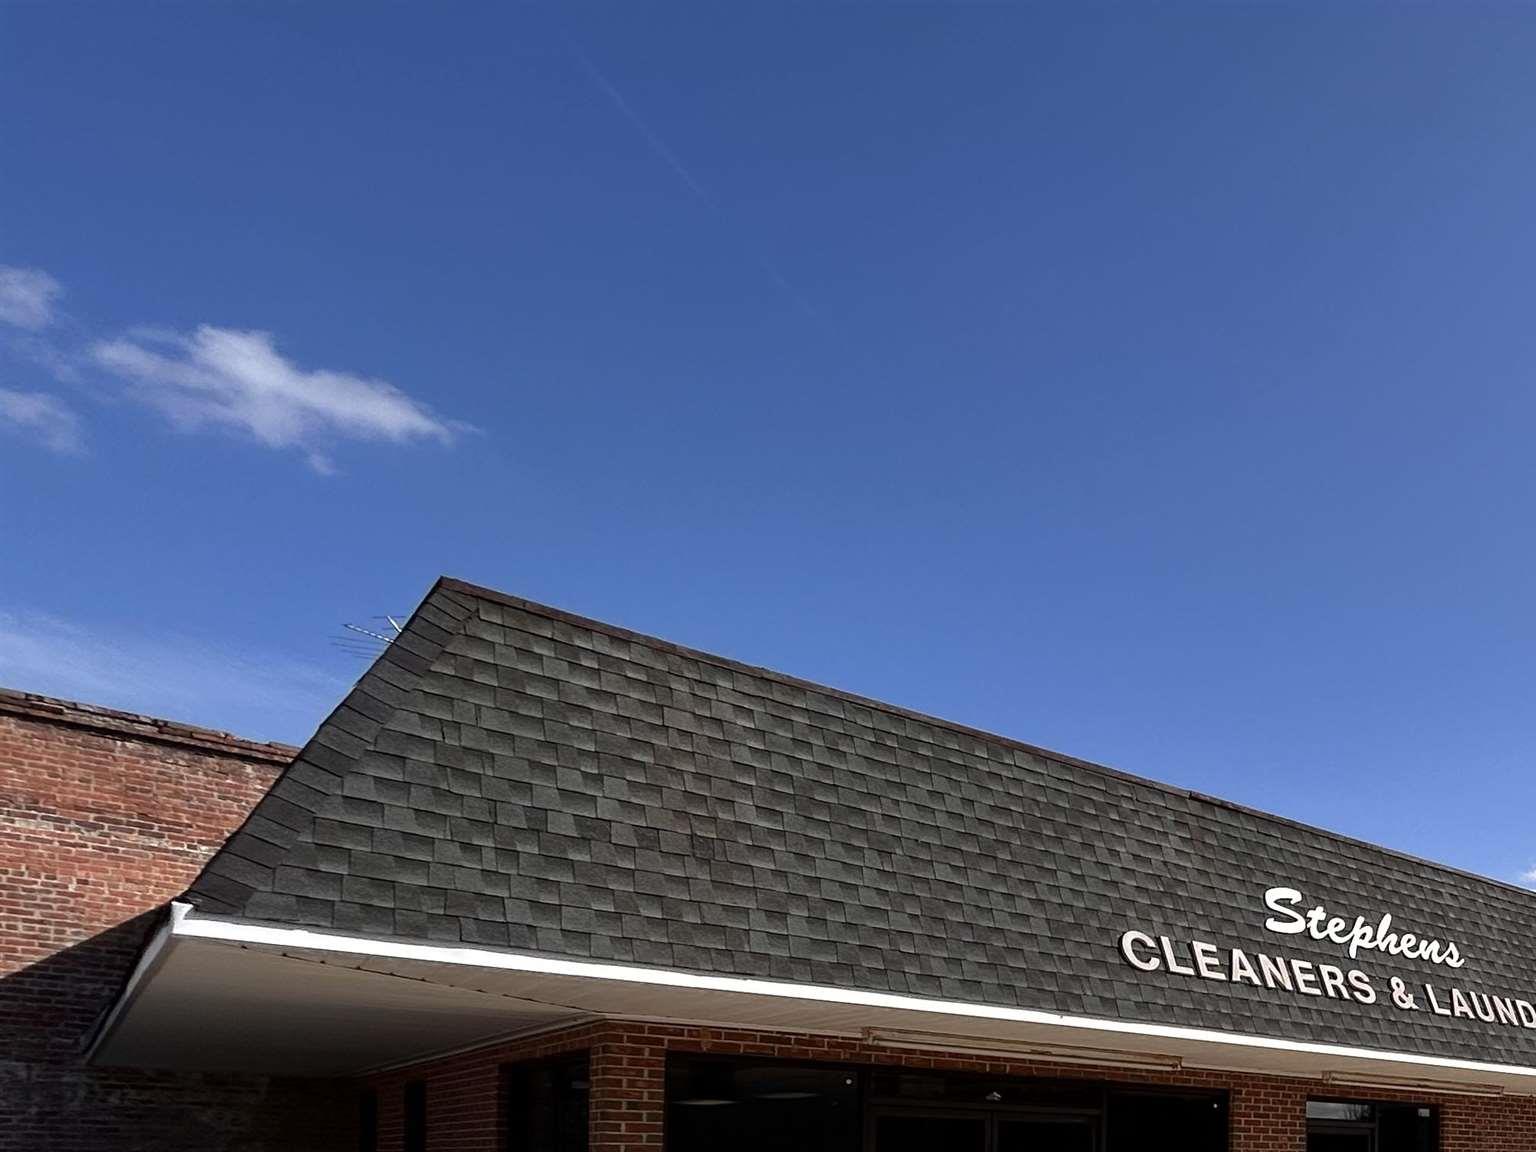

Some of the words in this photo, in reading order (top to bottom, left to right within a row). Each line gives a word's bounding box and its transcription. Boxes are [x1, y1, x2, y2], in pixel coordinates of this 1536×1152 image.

[1264, 887, 1466, 969] Stephens
[1119, 929, 1378, 1005] CLEANERS
[1389, 976, 1420, 1011] &
